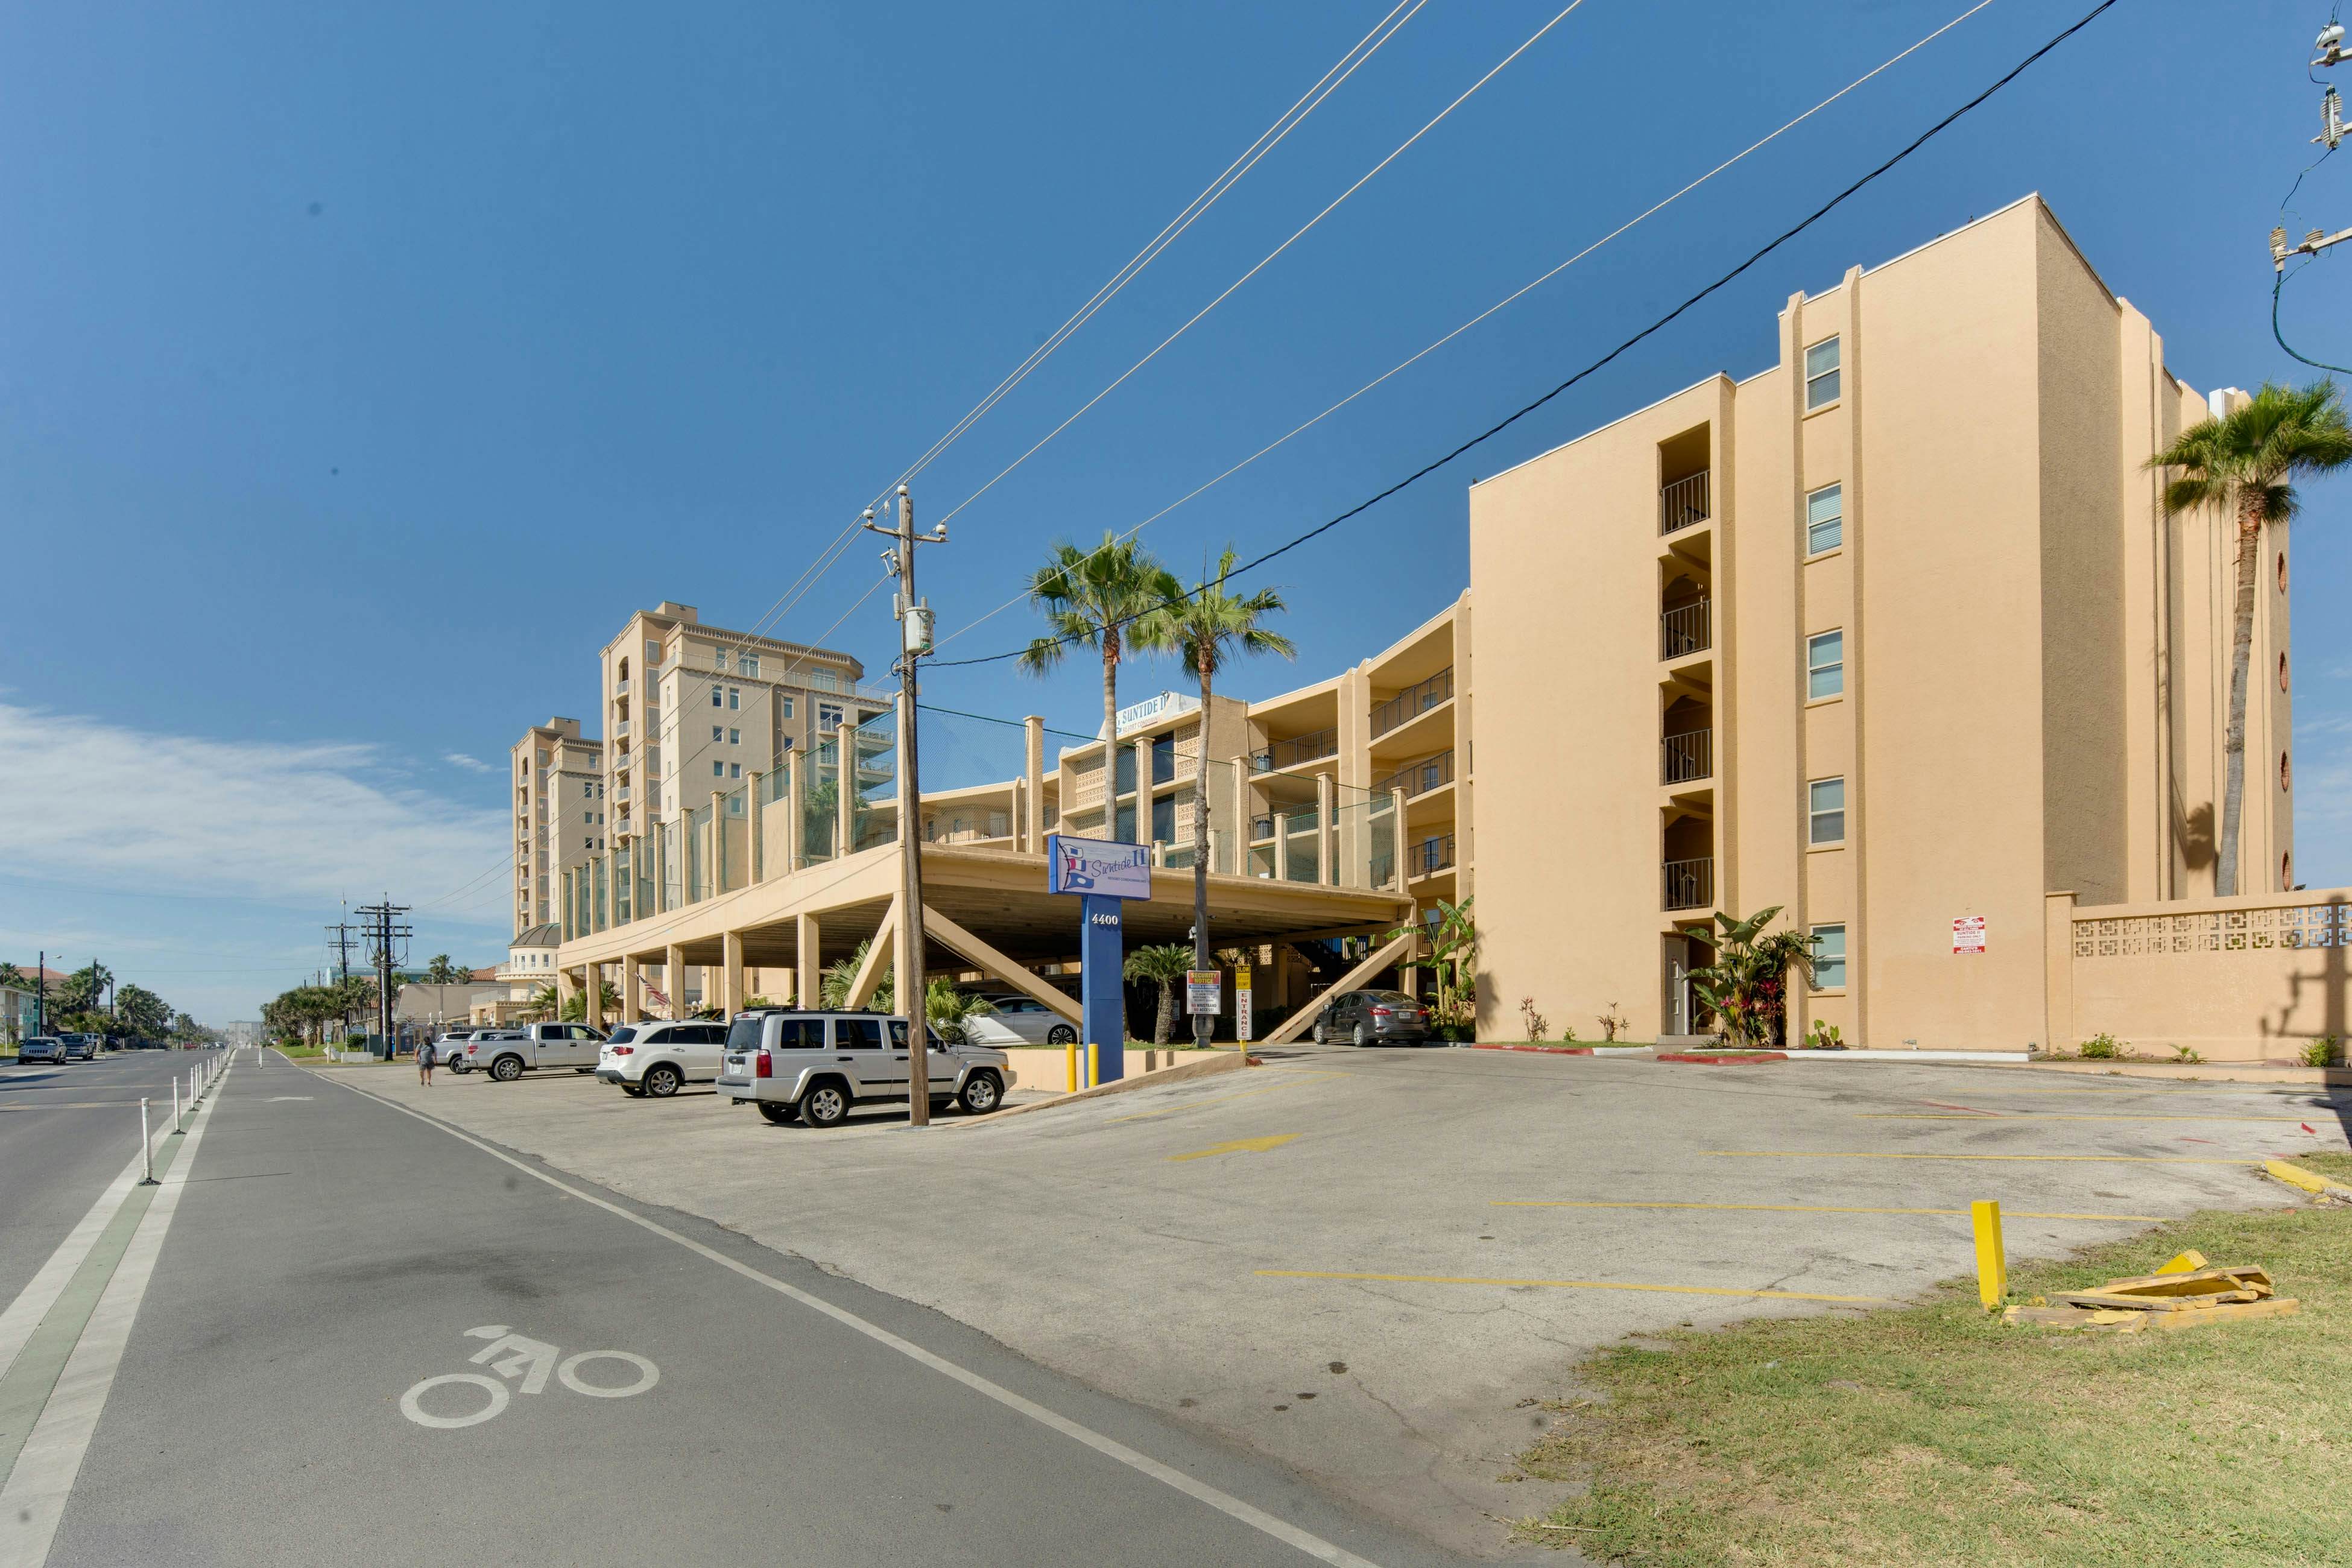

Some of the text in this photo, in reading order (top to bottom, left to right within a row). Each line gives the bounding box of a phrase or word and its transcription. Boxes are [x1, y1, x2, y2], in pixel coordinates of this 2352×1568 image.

[1122, 700, 1158, 724] SUNTIDE
[1092, 848, 1146, 877] Suntide II
[1092, 914, 1118, 925] 4400
